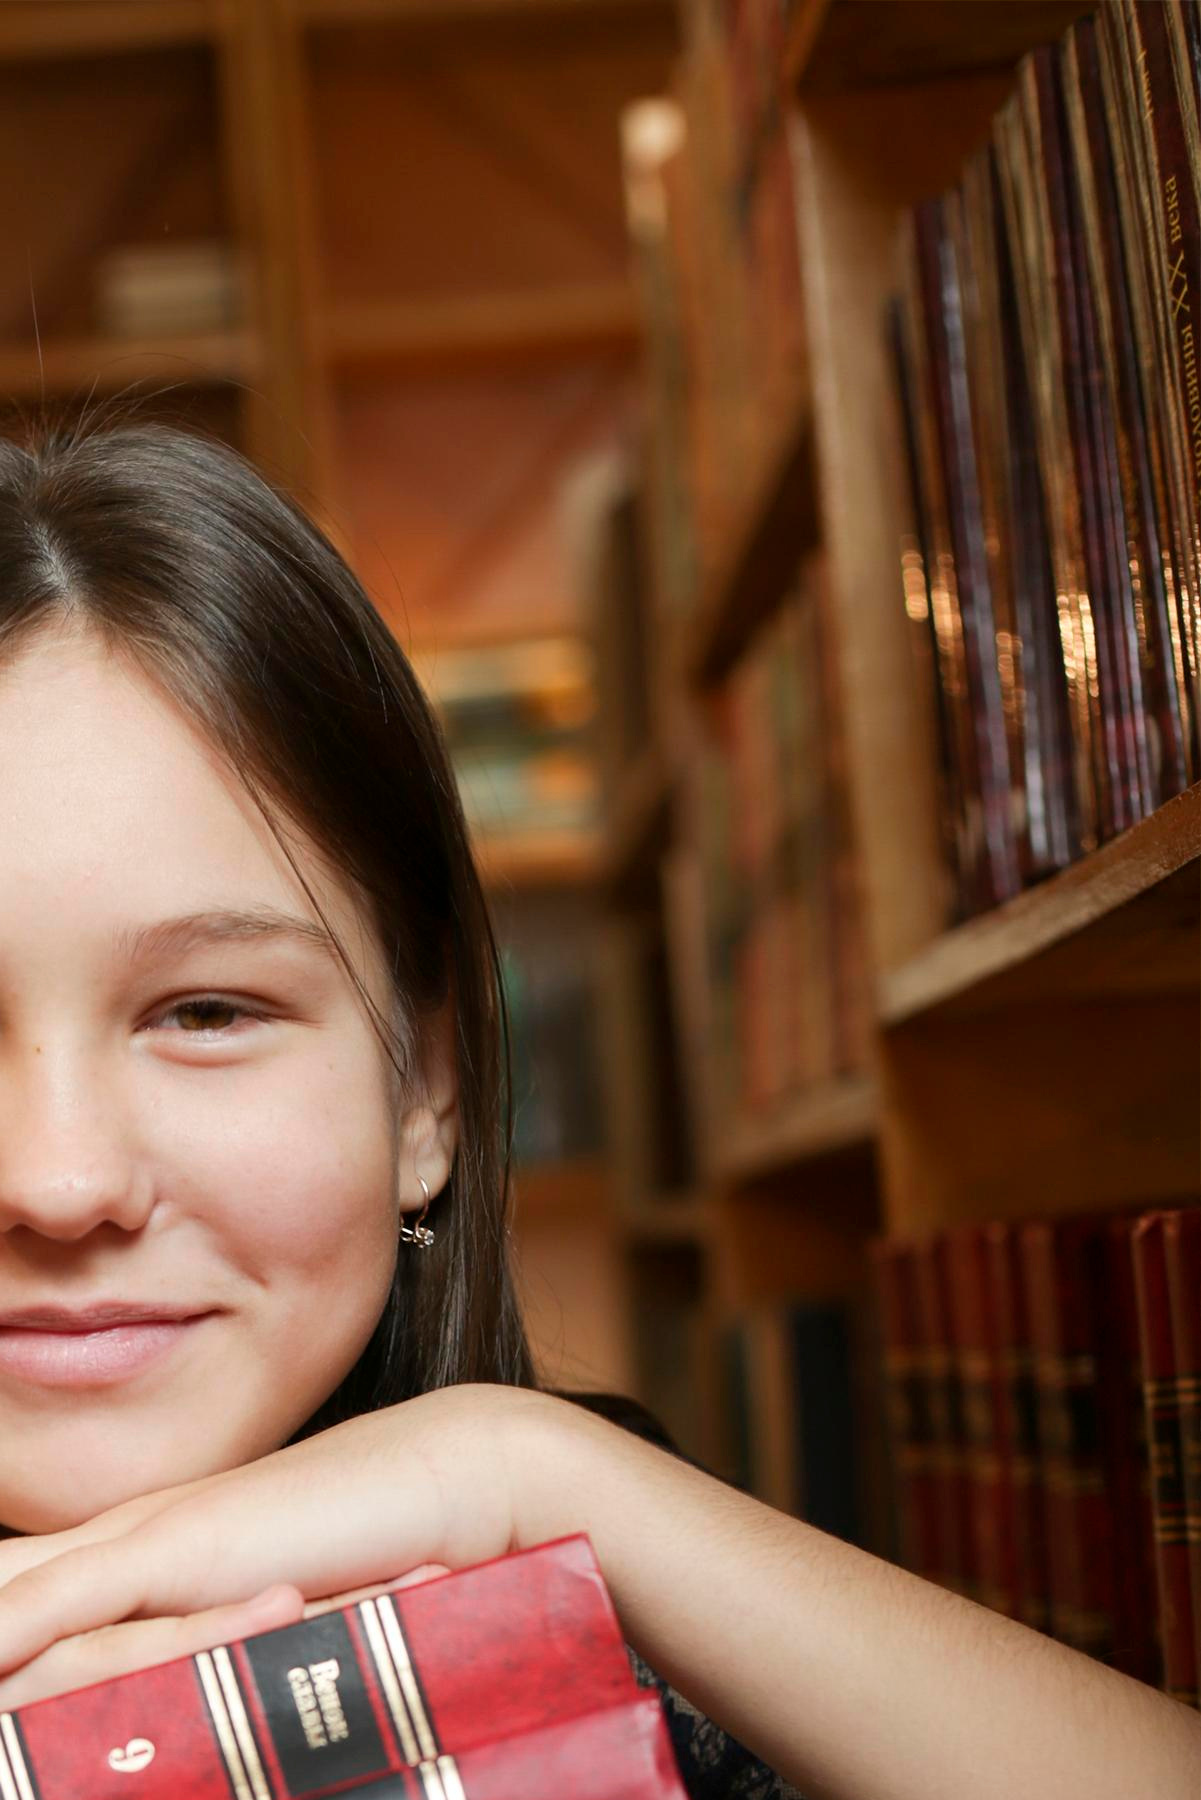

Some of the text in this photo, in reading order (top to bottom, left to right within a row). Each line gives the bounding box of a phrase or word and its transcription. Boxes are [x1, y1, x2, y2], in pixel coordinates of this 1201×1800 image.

[1165, 175, 1182, 243] века
[287, 1666, 327, 1748] славы
[308, 1657, 348, 1740] Венок
[108, 1738, 155, 1773] 9
